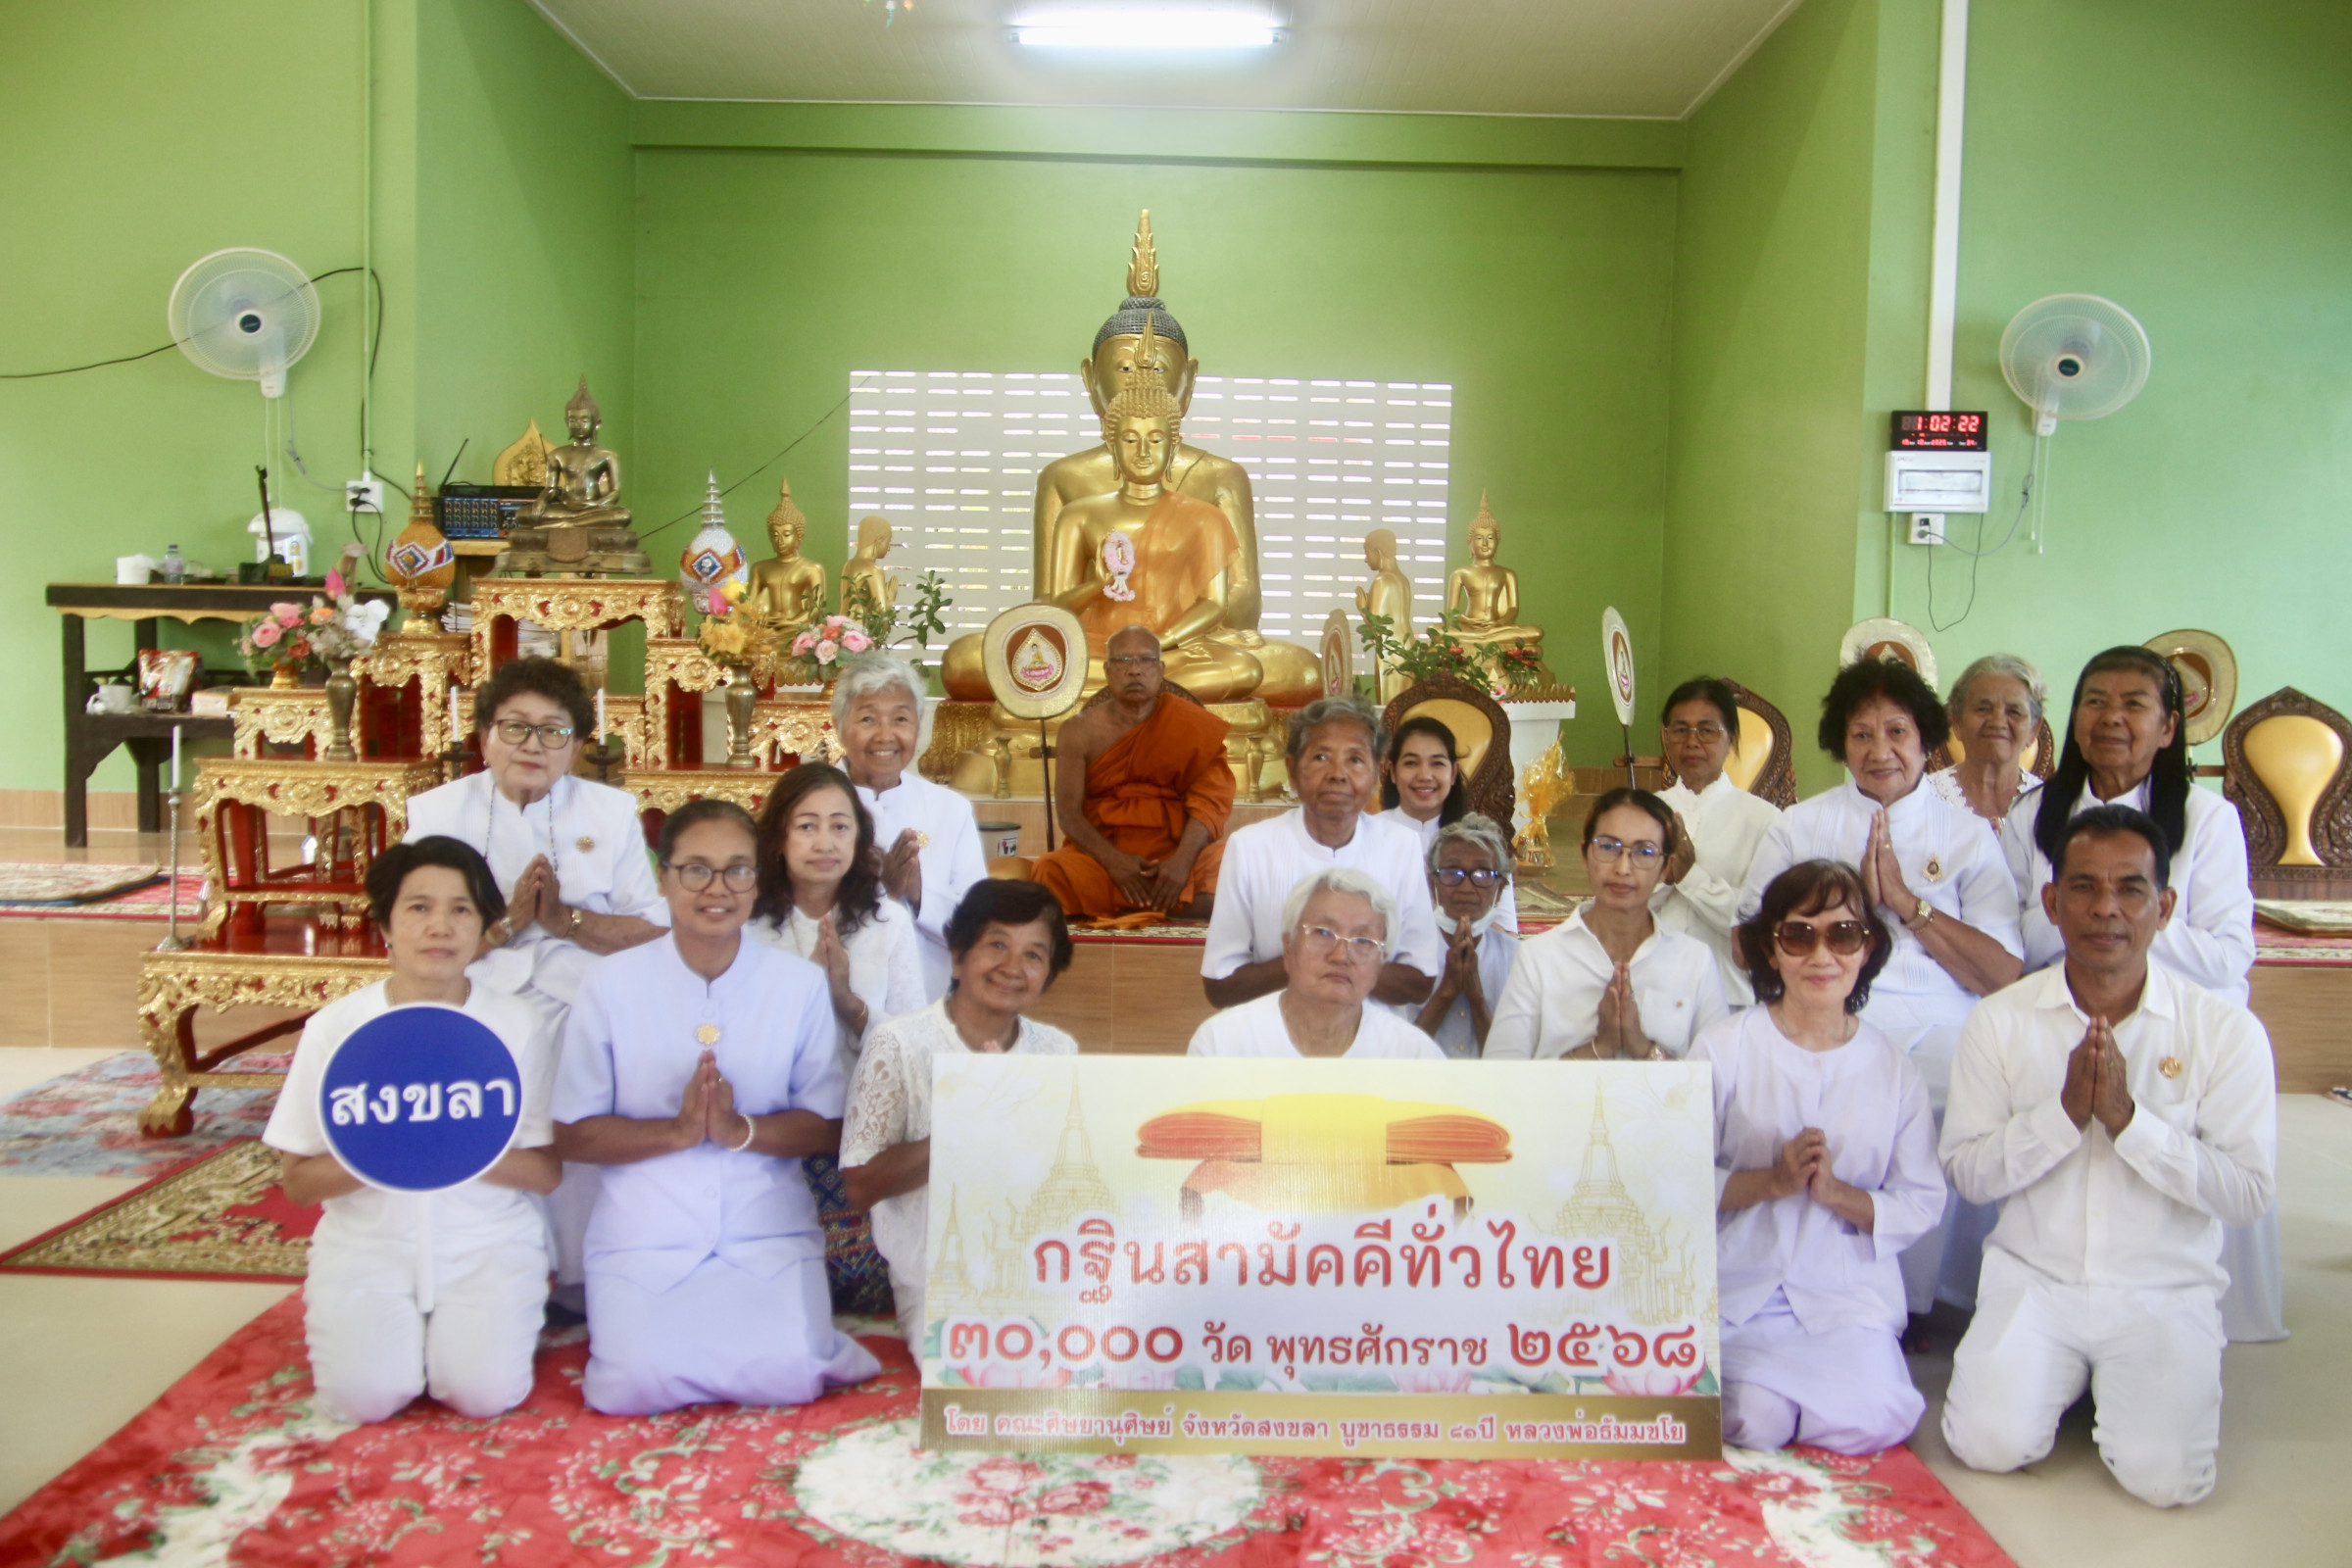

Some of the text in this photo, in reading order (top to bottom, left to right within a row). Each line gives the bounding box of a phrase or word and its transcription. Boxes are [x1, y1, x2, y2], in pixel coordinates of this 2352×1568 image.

[329, 1079, 514, 1125] สงขลา
[1034, 1202, 1610, 1303] กฐินสามัคคีทั่วไทย
[950, 1320, 1696, 1381] ๓๐,๐๐๐ วัด พุทธศักราช ๒๕๖๘
[946, 1406, 986, 1434] โดย
[996, 1405, 1173, 1444] คณะศิษยานุศิษย์
[1183, 1412, 1328, 1438] จังหวัดสงขลา
